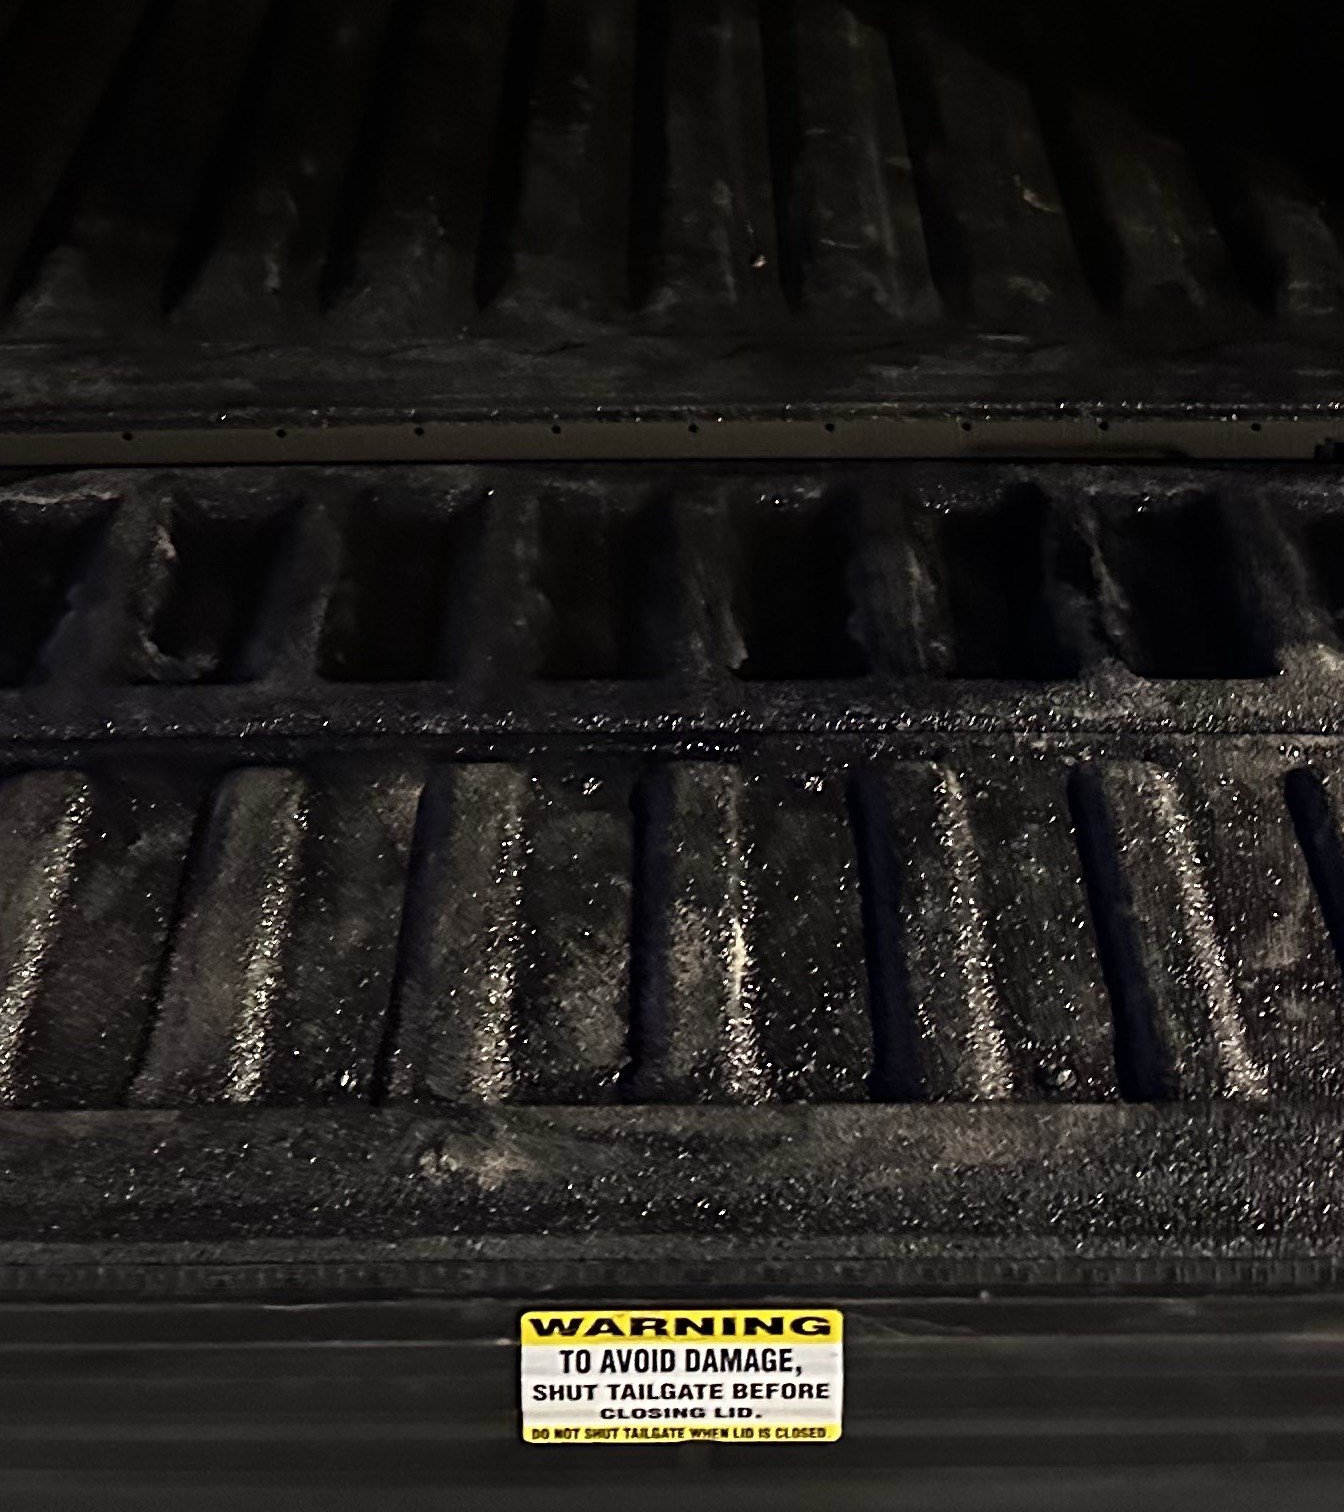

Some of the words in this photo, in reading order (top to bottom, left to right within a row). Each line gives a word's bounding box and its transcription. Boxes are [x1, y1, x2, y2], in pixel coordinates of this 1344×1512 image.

[529, 1316, 832, 1337] WARNING
[559, 1348, 591, 1374] TO
[600, 1348, 676, 1374] AVOID
[685, 1347, 803, 1377] DAMAGE,
[532, 1383, 598, 1402] SHUT
[606, 1382, 724, 1401] TAILGATE
[732, 1382, 831, 1400] BEFORE
[599, 1407, 706, 1420] CLOSING
[714, 1406, 763, 1420] LID.
[531, 1428, 550, 1440] DO
[554, 1427, 581, 1440] NOT
[584, 1427, 619, 1440] SHUT
[623, 1427, 686, 1439] TAILGATE
[689, 1427, 729, 1439] WHEN
[733, 1427, 754, 1439] LID
[758, 1427, 771, 1439] IS
